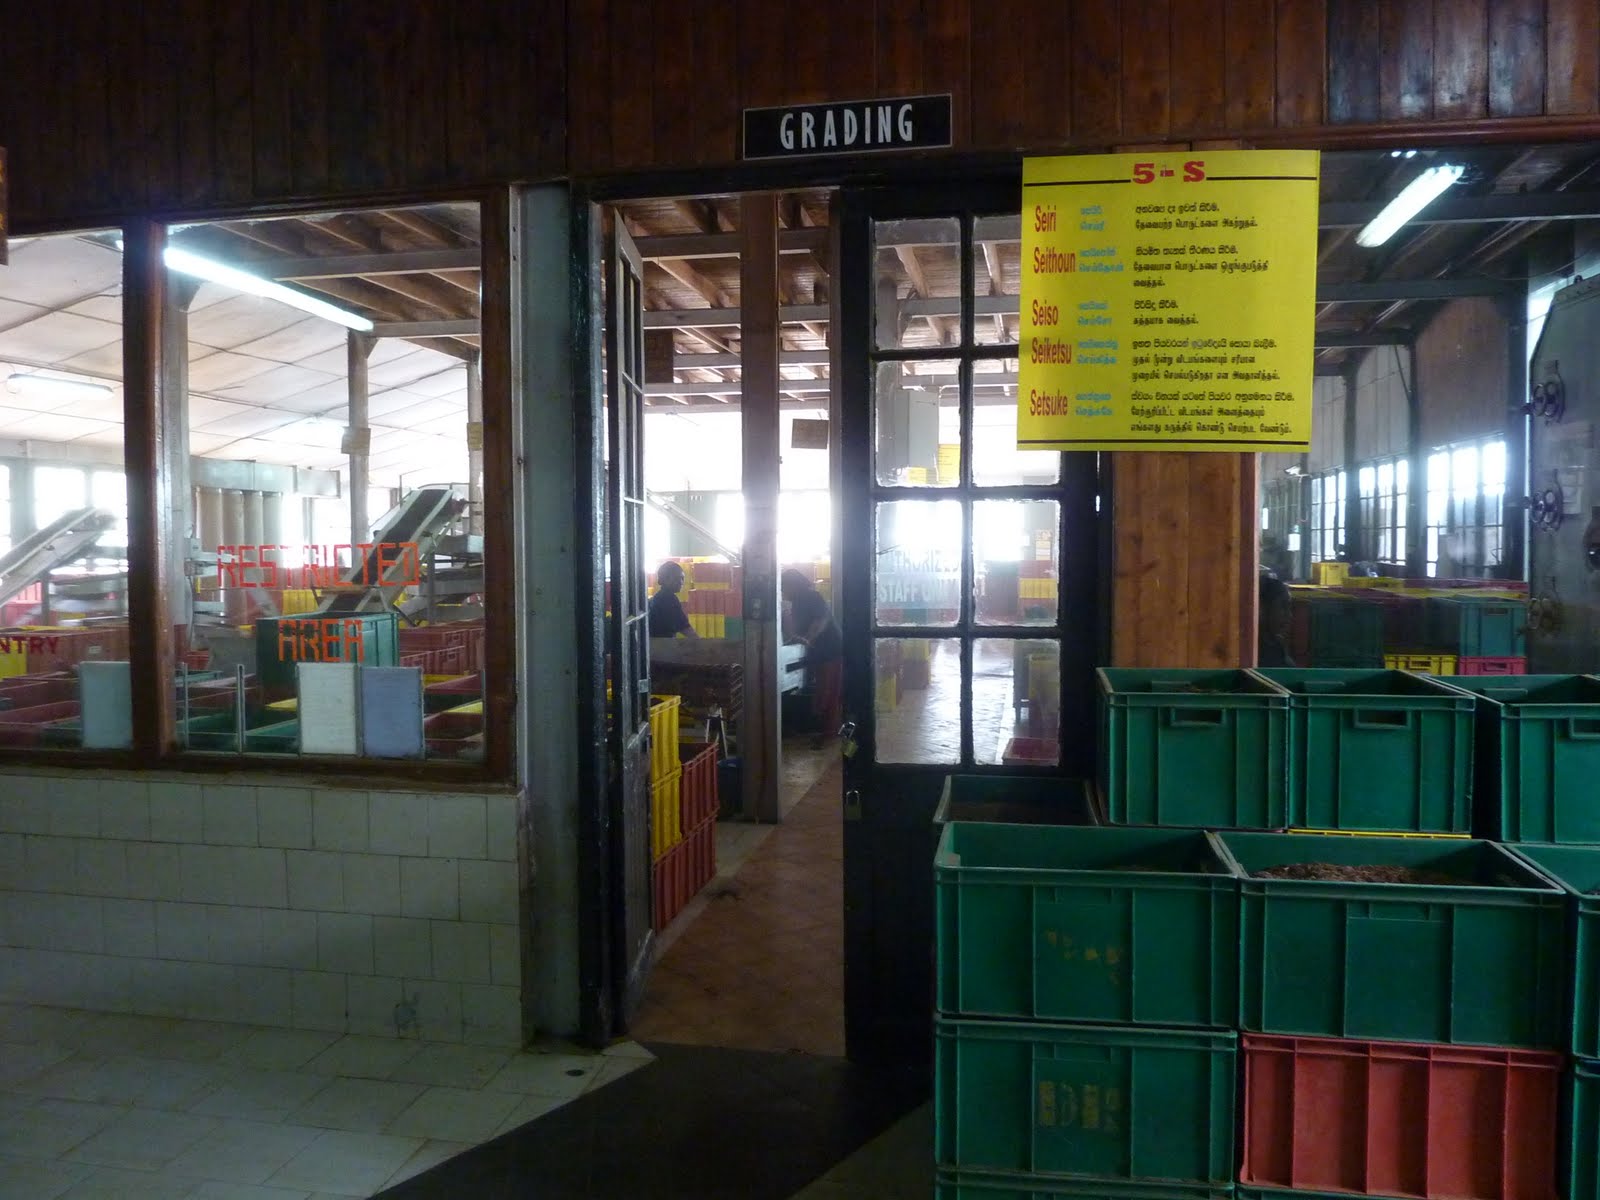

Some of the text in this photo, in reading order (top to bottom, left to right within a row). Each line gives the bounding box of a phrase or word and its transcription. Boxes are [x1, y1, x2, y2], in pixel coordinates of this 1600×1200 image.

[780, 103, 913, 150] GRADING
[1036, 206, 1056, 232] Seiri
[1035, 247, 1075, 273] Seithoun
[1033, 300, 1058, 325] Seiso
[1032, 338, 1071, 363] Seiketsu
[1031, 390, 1067, 415] Setsuke
[217, 542, 420, 588] RESTRICTED
[278, 619, 364, 662] AREA
